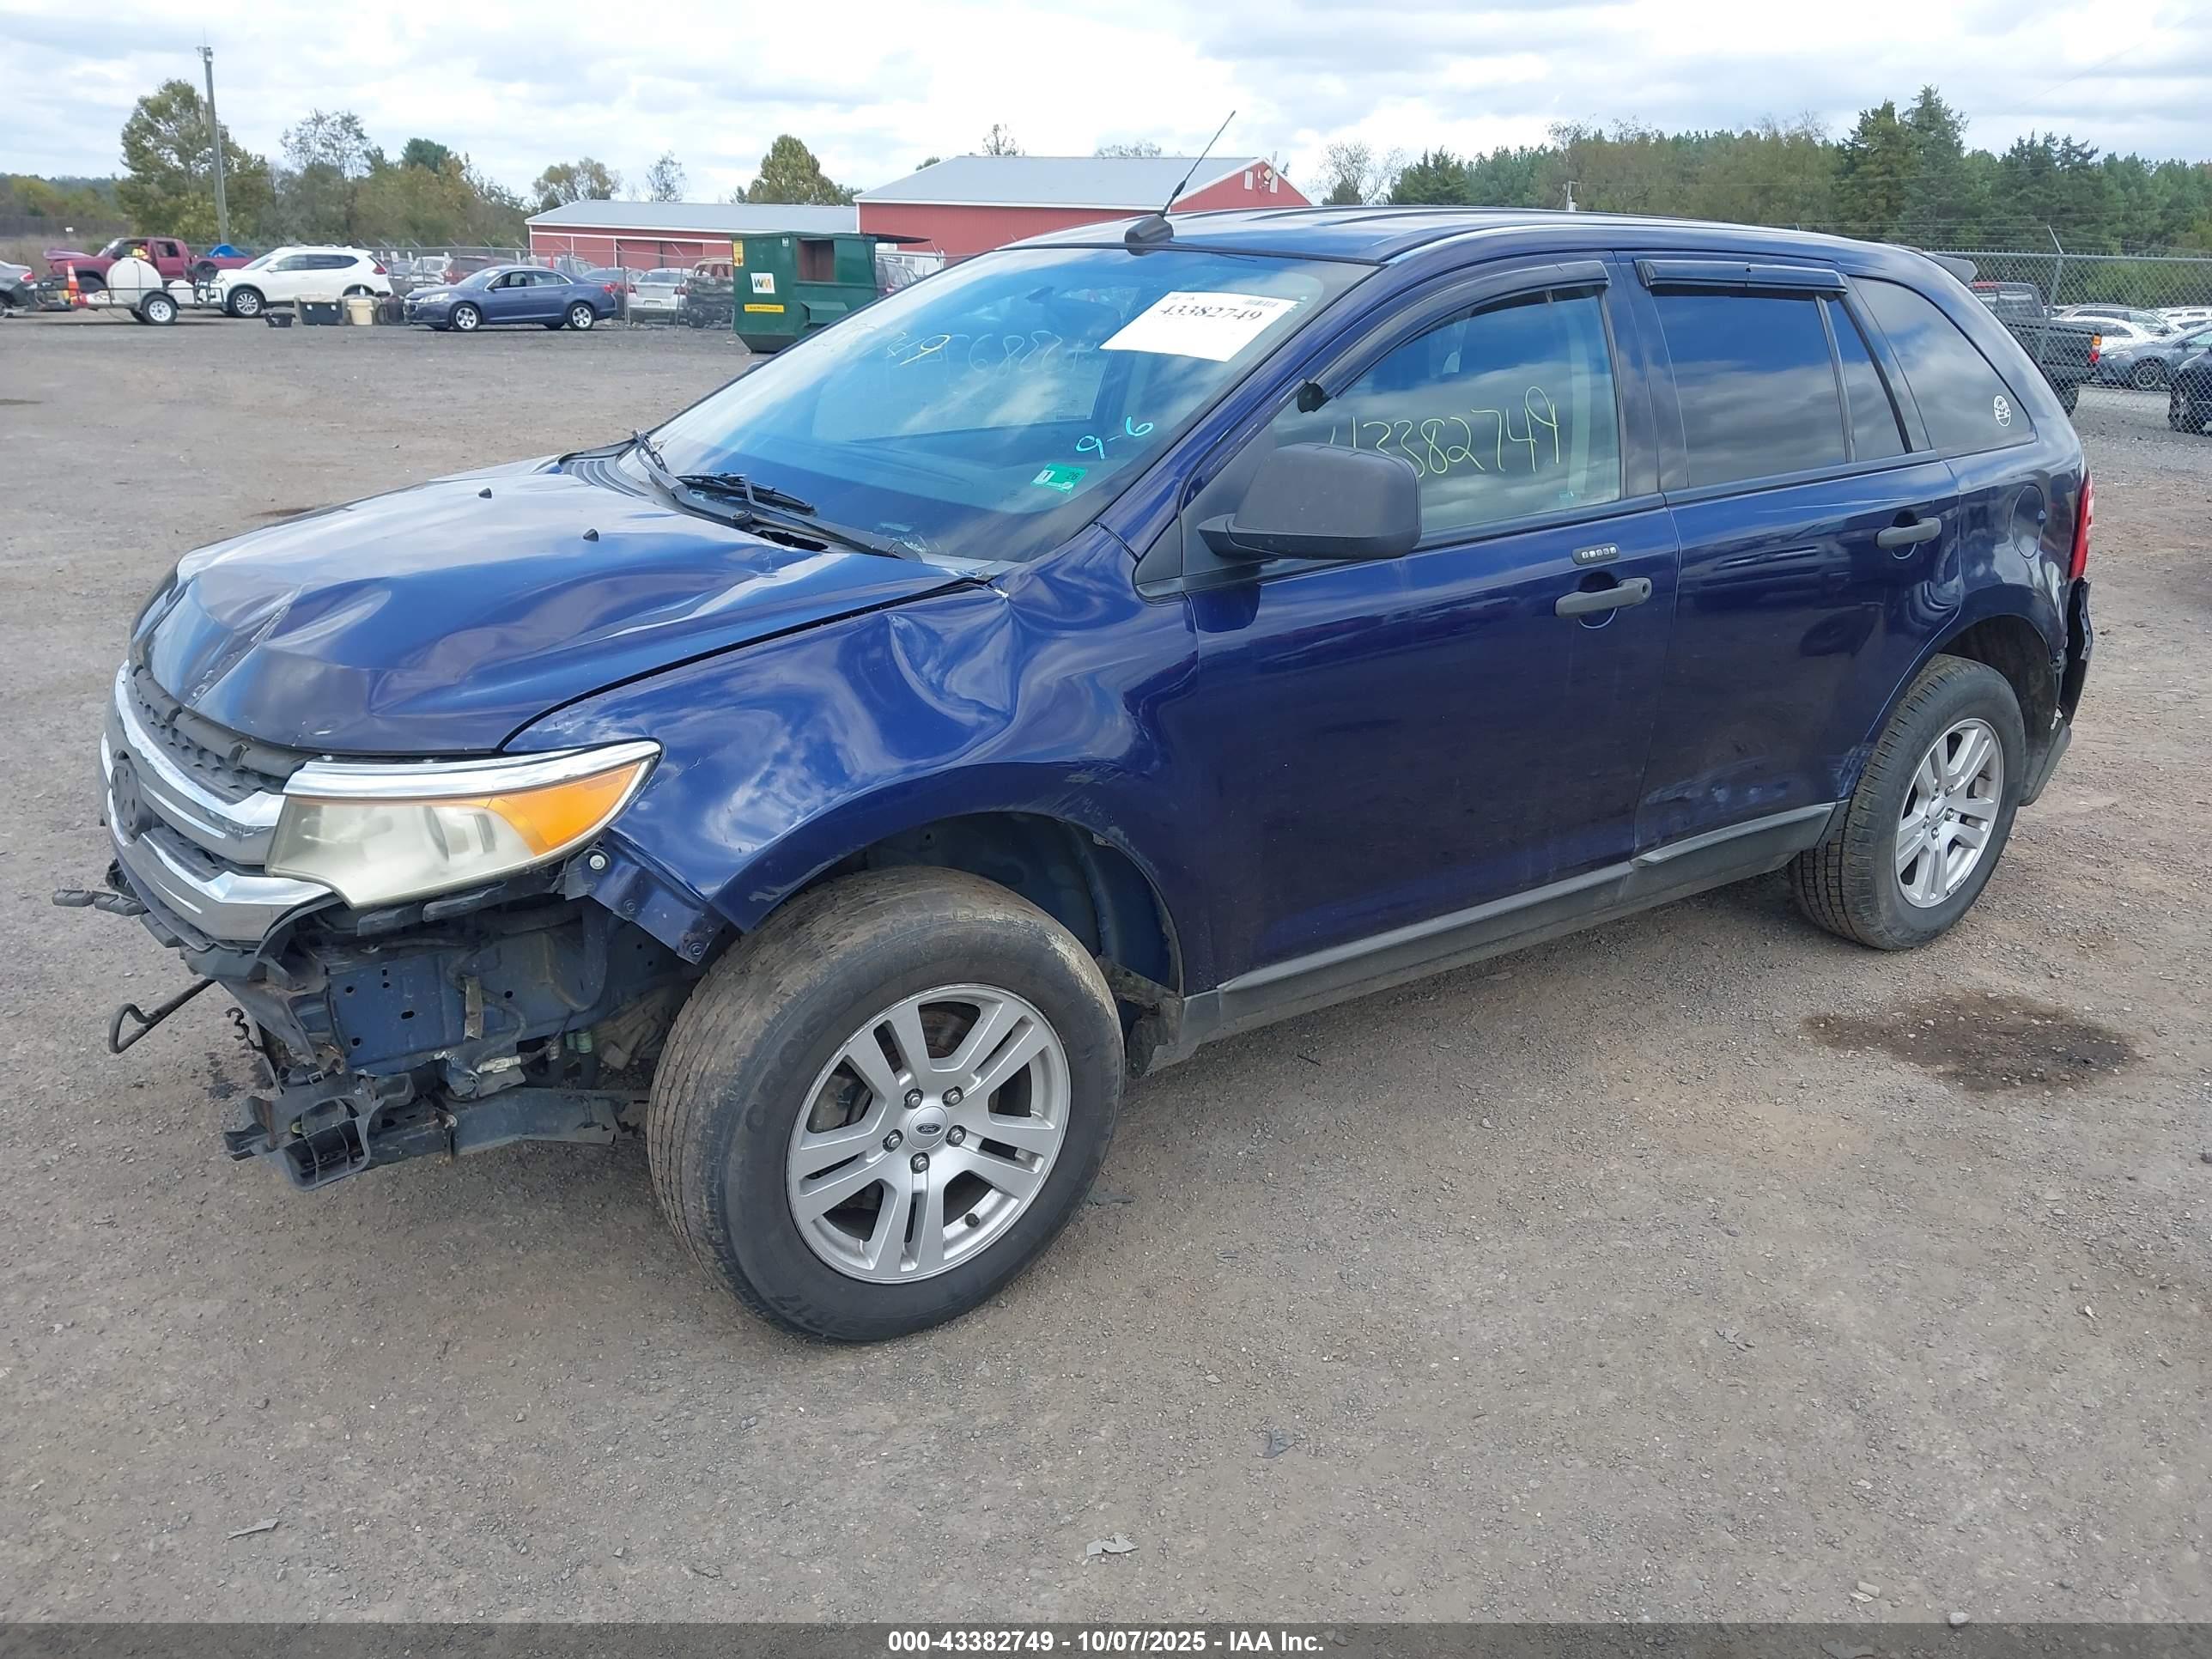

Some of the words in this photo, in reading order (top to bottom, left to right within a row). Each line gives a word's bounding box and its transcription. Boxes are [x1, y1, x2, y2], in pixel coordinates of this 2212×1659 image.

[754, 278, 772, 289] WM
[1161, 304, 1263, 321] 43382749
[1075, 416, 1155, 460] 9-6
